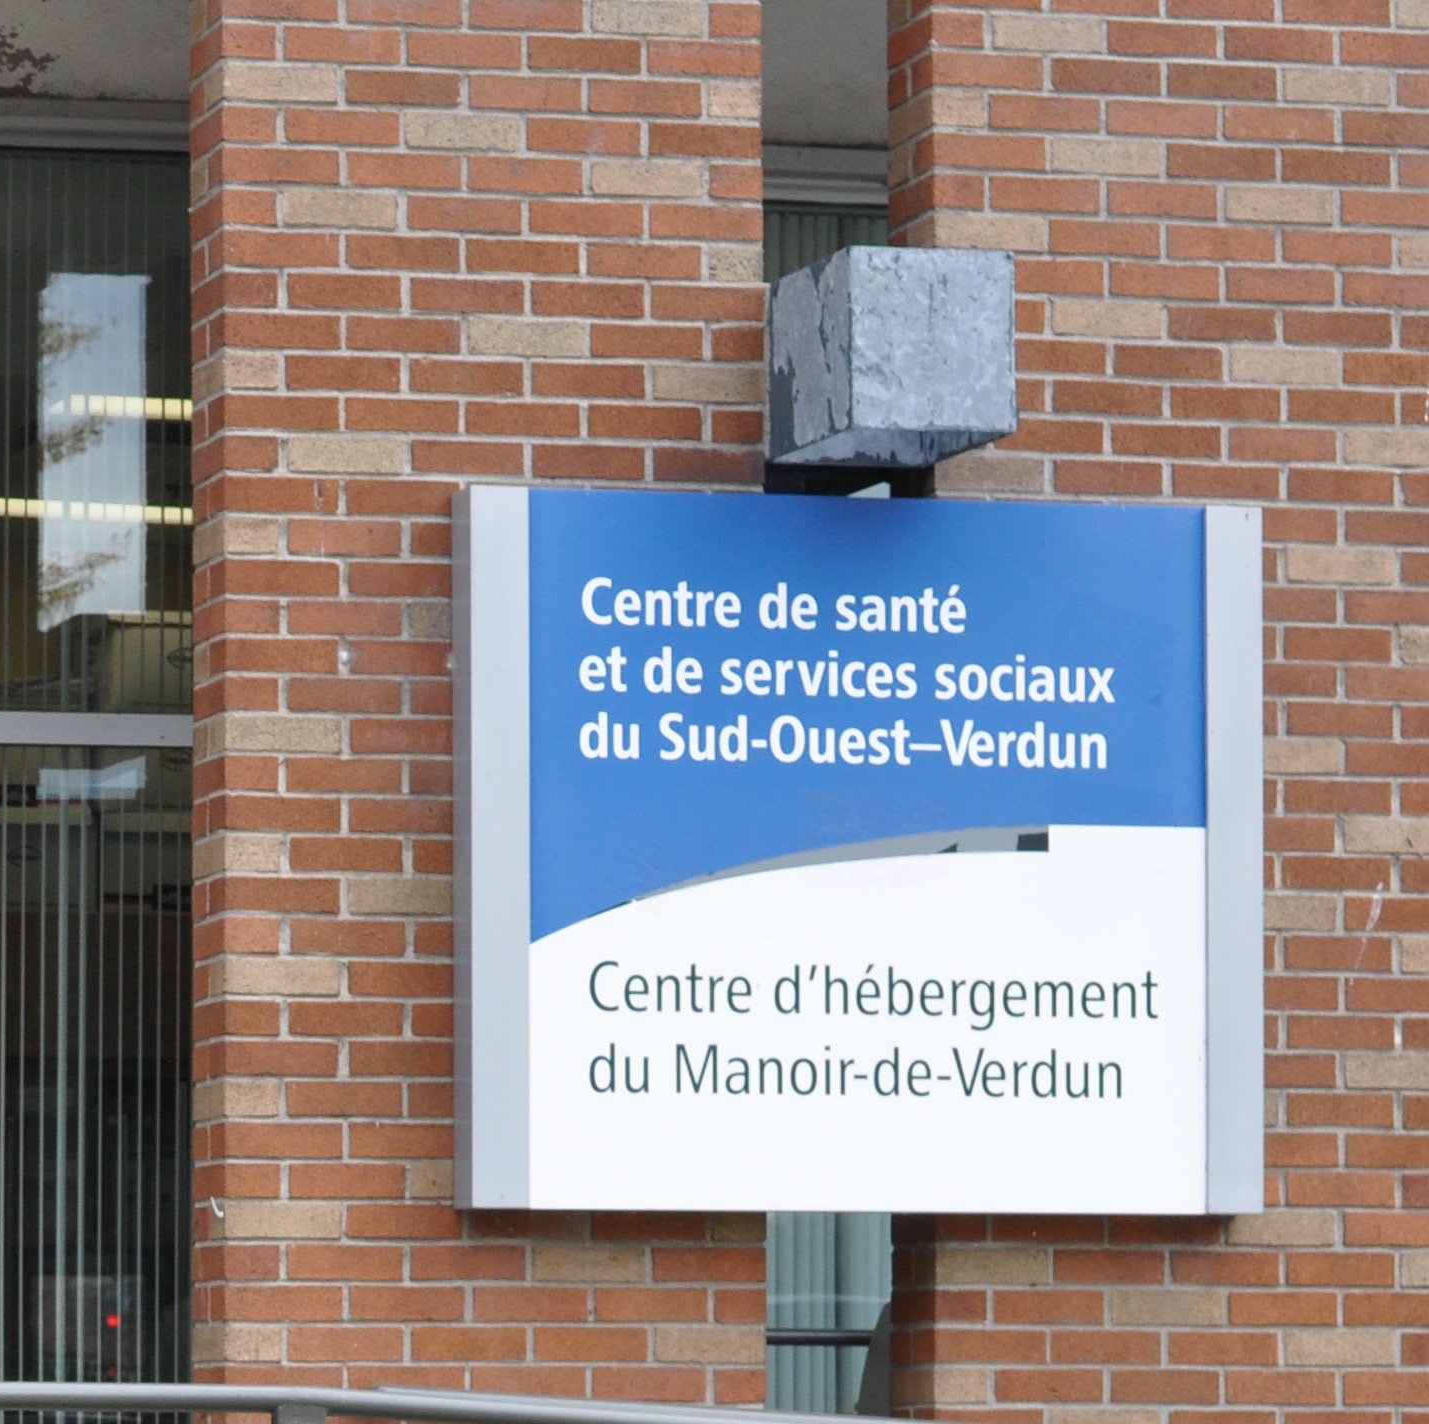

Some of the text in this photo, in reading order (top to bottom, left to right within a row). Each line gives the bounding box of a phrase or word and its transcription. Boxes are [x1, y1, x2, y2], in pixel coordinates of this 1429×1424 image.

[581, 576, 967, 634] Centre de santé
[578, 645, 1116, 704] et de services sociaux
[579, 711, 640, 760] du
[589, 960, 1158, 1031] Centre d'hébergement
[589, 1043, 1122, 1099] du Manoir-de-Verdun
